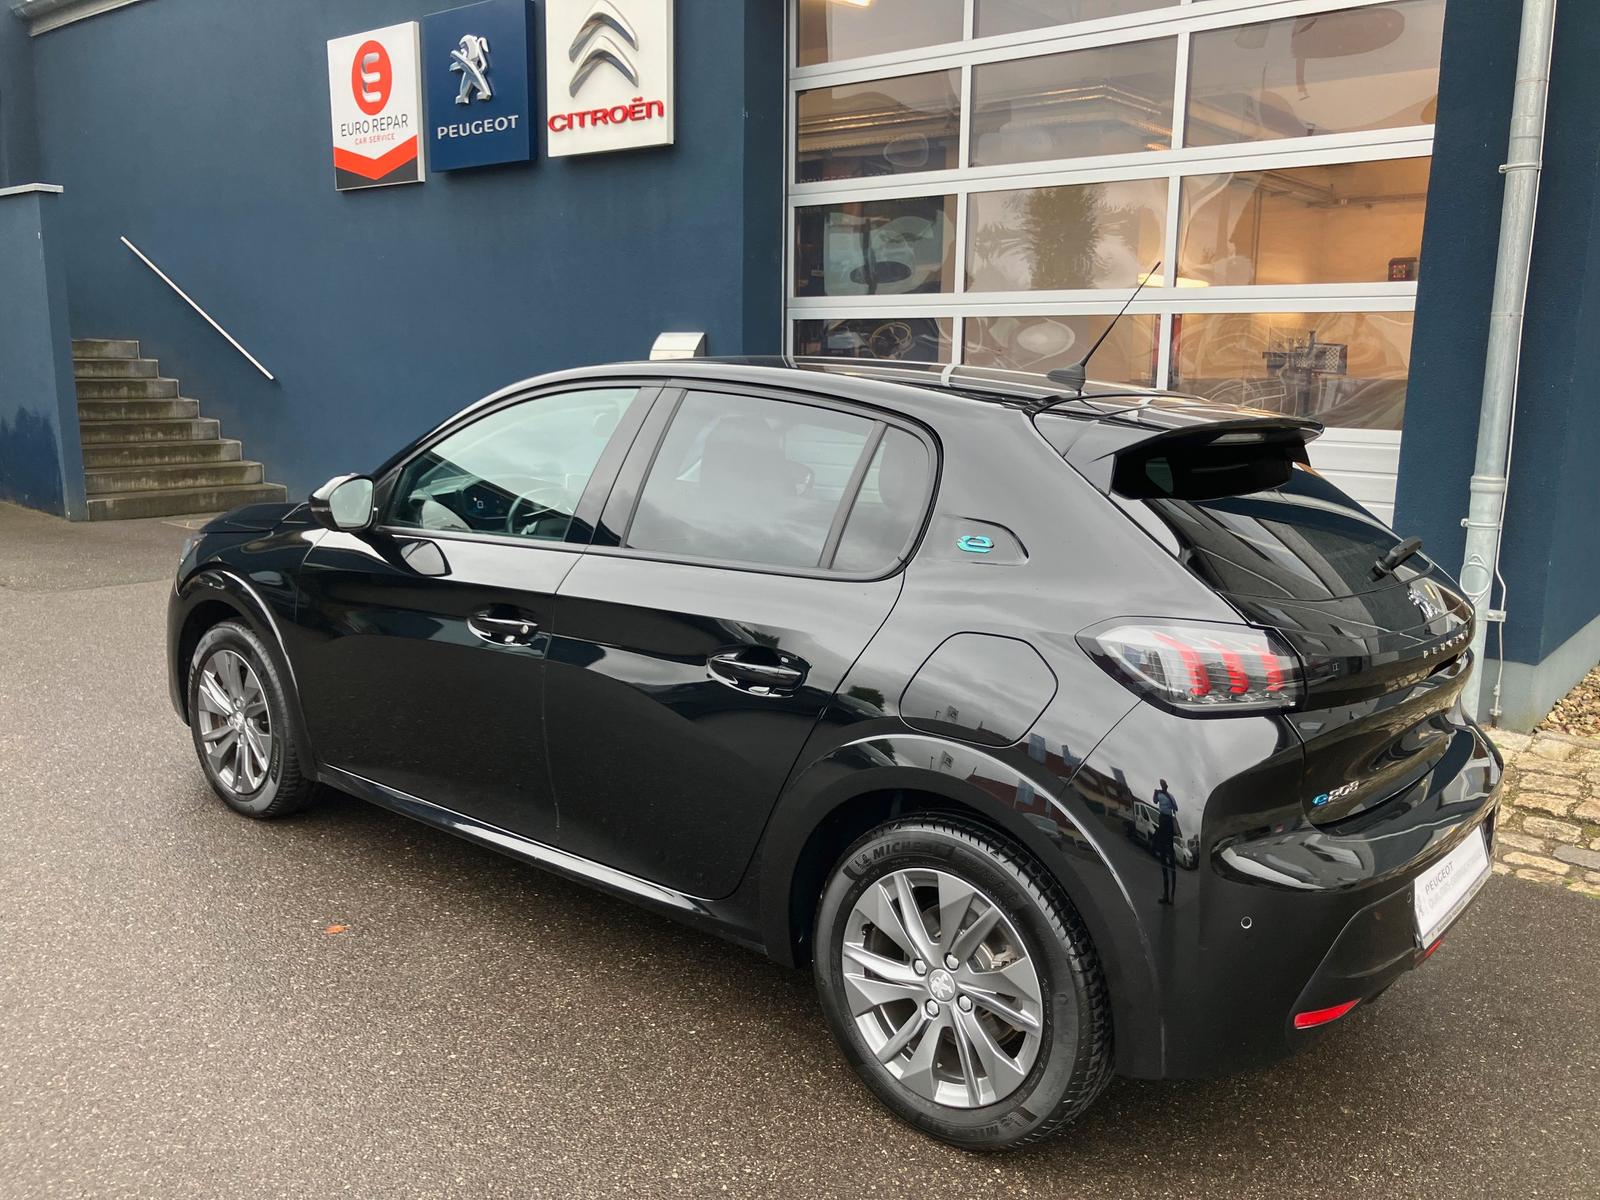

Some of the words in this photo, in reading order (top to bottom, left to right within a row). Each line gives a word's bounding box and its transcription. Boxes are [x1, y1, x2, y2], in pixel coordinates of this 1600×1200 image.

[341, 120, 370, 137] EURO
[372, 113, 409, 132] REPAR
[437, 114, 519, 140] PEUGEOT
[355, 136, 368, 146] CAR
[369, 132, 396, 144] SERVICE
[1424, 861, 1455, 893] PEUGEOT
